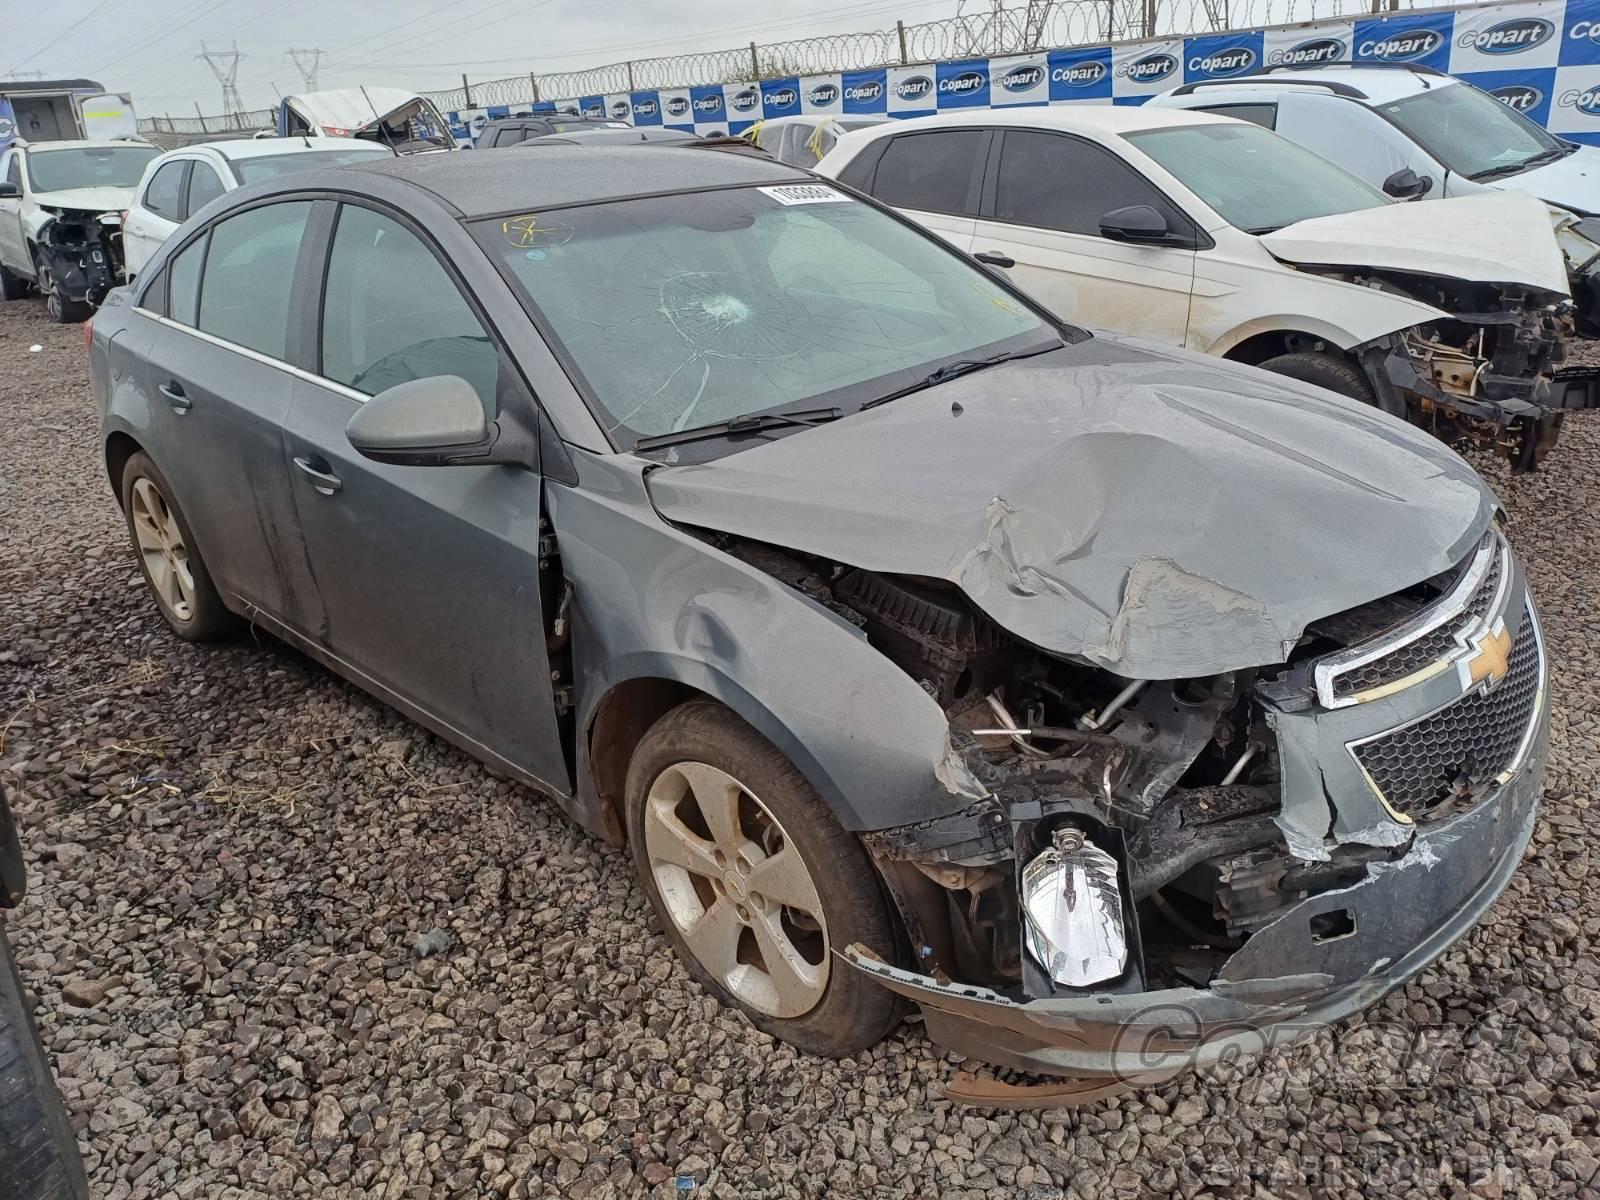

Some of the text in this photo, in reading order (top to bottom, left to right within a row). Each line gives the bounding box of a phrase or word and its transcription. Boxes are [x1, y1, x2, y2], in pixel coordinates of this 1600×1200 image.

[1358, 33, 1434, 58] Copart
[1457, 21, 1543, 52] Copart
[1188, 51, 1249, 73] Copart
[1268, 43, 1336, 66] Copart
[1051, 65, 1100, 82] Copart
[1116, 59, 1171, 78] Copart
[890, 80, 928, 96] Copart
[939, 75, 981, 92] Copart
[992, 69, 1040, 88] Copart
[764, 92, 794, 106] Copart
[844, 86, 879, 100] Copart
[1558, 89, 1600, 109] Cop
[693, 98, 719, 111] Copart
